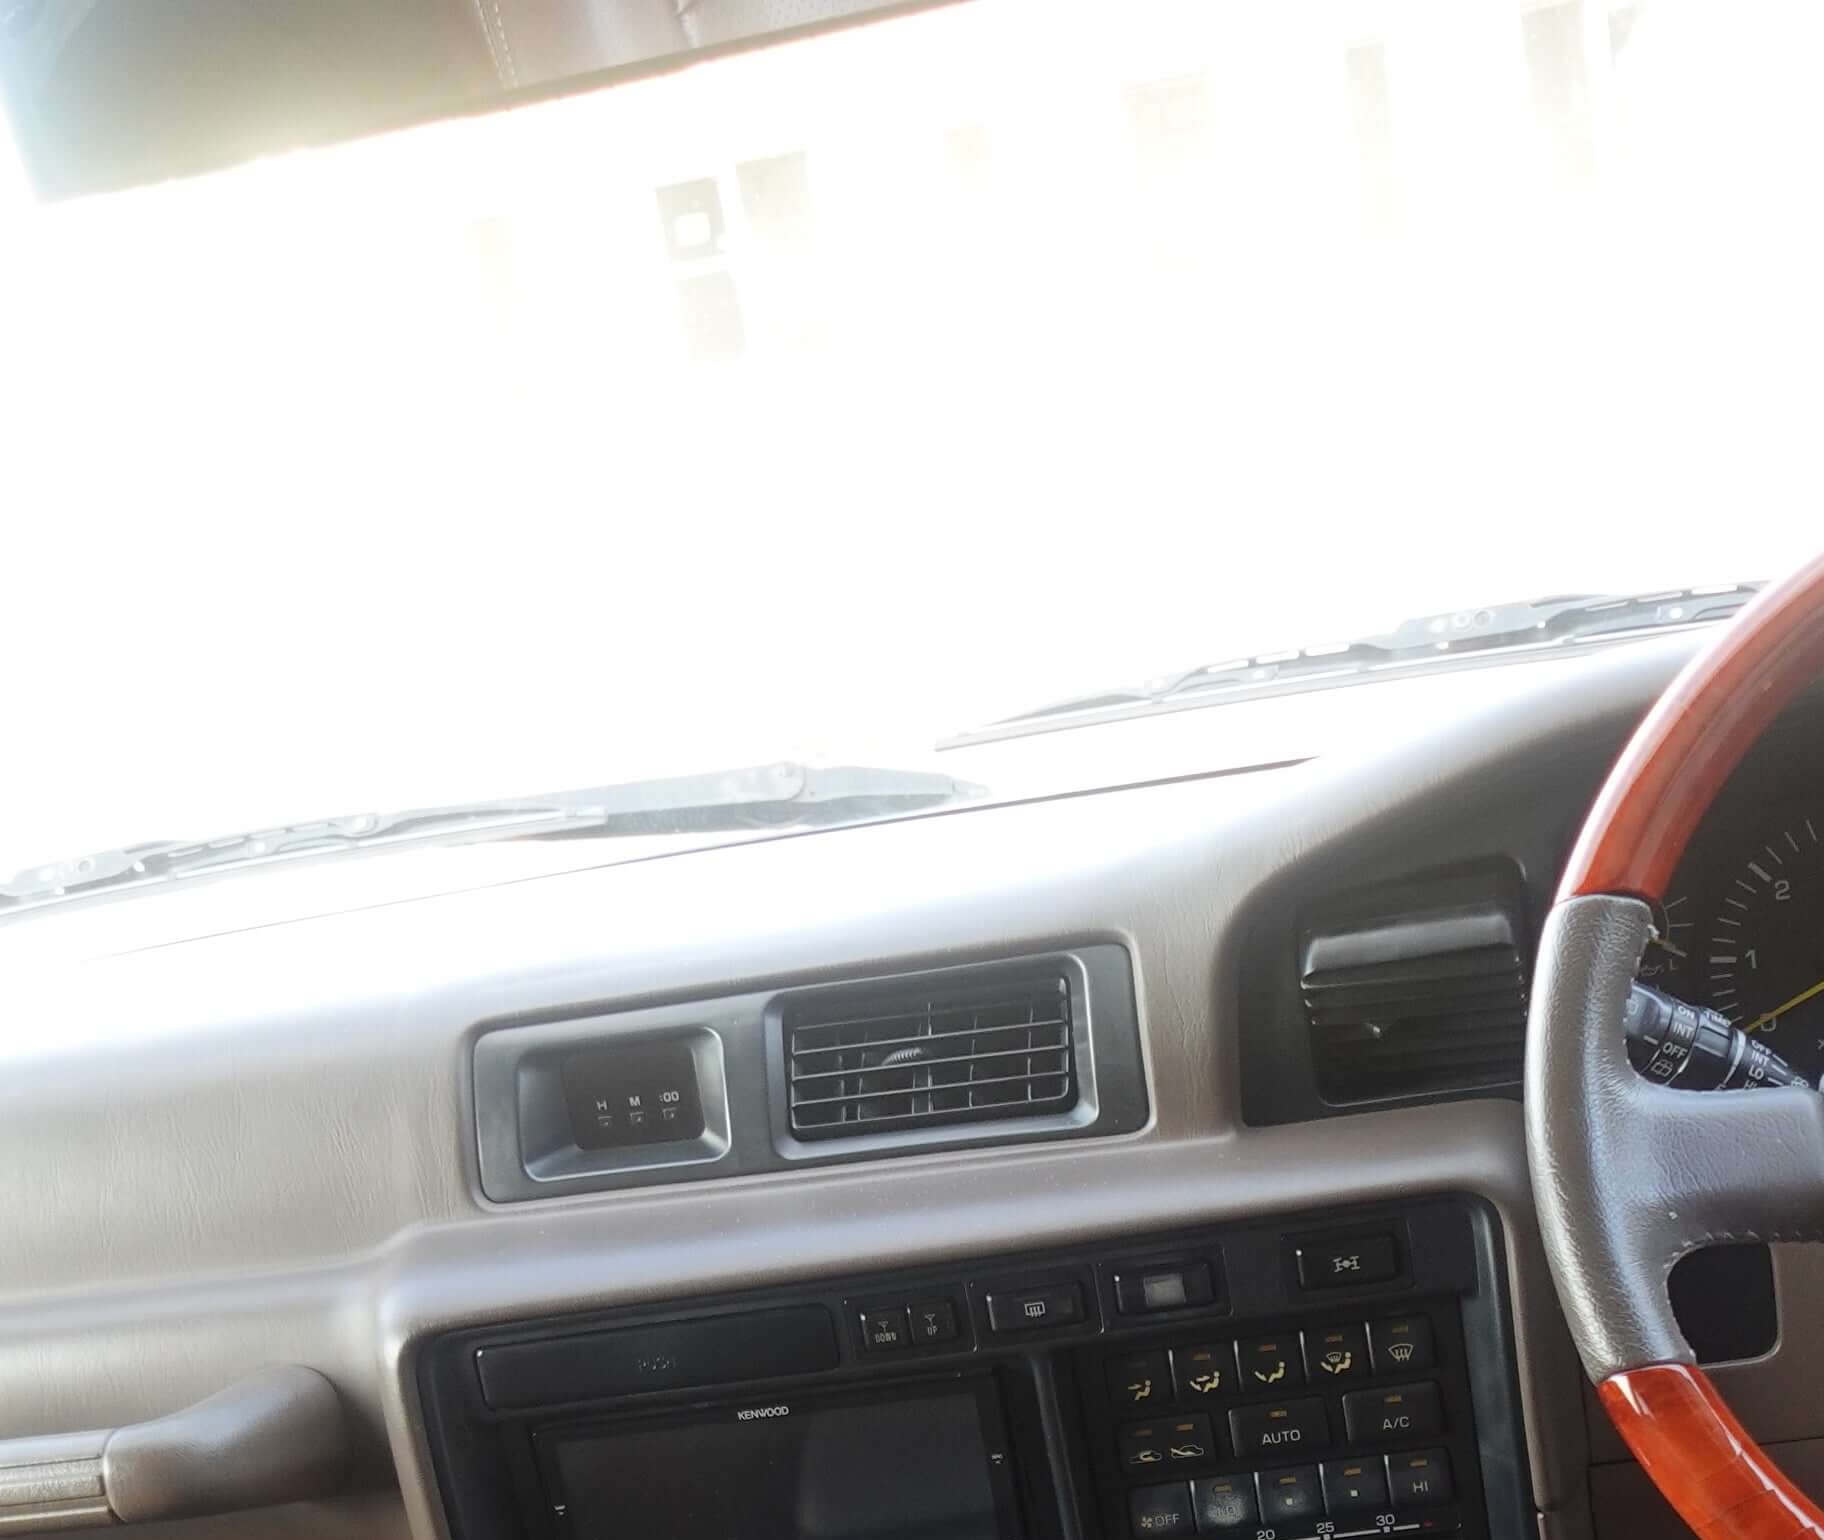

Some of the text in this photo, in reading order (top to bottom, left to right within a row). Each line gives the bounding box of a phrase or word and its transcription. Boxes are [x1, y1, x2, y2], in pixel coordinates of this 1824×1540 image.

[1774, 879, 1792, 901] 2
[1745, 949, 1758, 970] 1
[1678, 1004, 1695, 1020] ON
[1672, 1022, 1695, 1039] INT
[1662, 1041, 1689, 1060] OFF
[1751, 1050, 1770, 1067] INT
[1748, 1065, 1765, 1081] LO
[597, 1100, 609, 1112] H
[629, 1095, 641, 1107] M
[736, 1404, 790, 1422] KENWOOD
[1382, 1415, 1410, 1431] A/C
[1262, 1428, 1301, 1446] AUTO
[1413, 1479, 1429, 1494] HI
[1154, 1513, 1180, 1528] OFF
[1316, 1521, 1335, 1535] 25
[1376, 1513, 1396, 1527] 30
